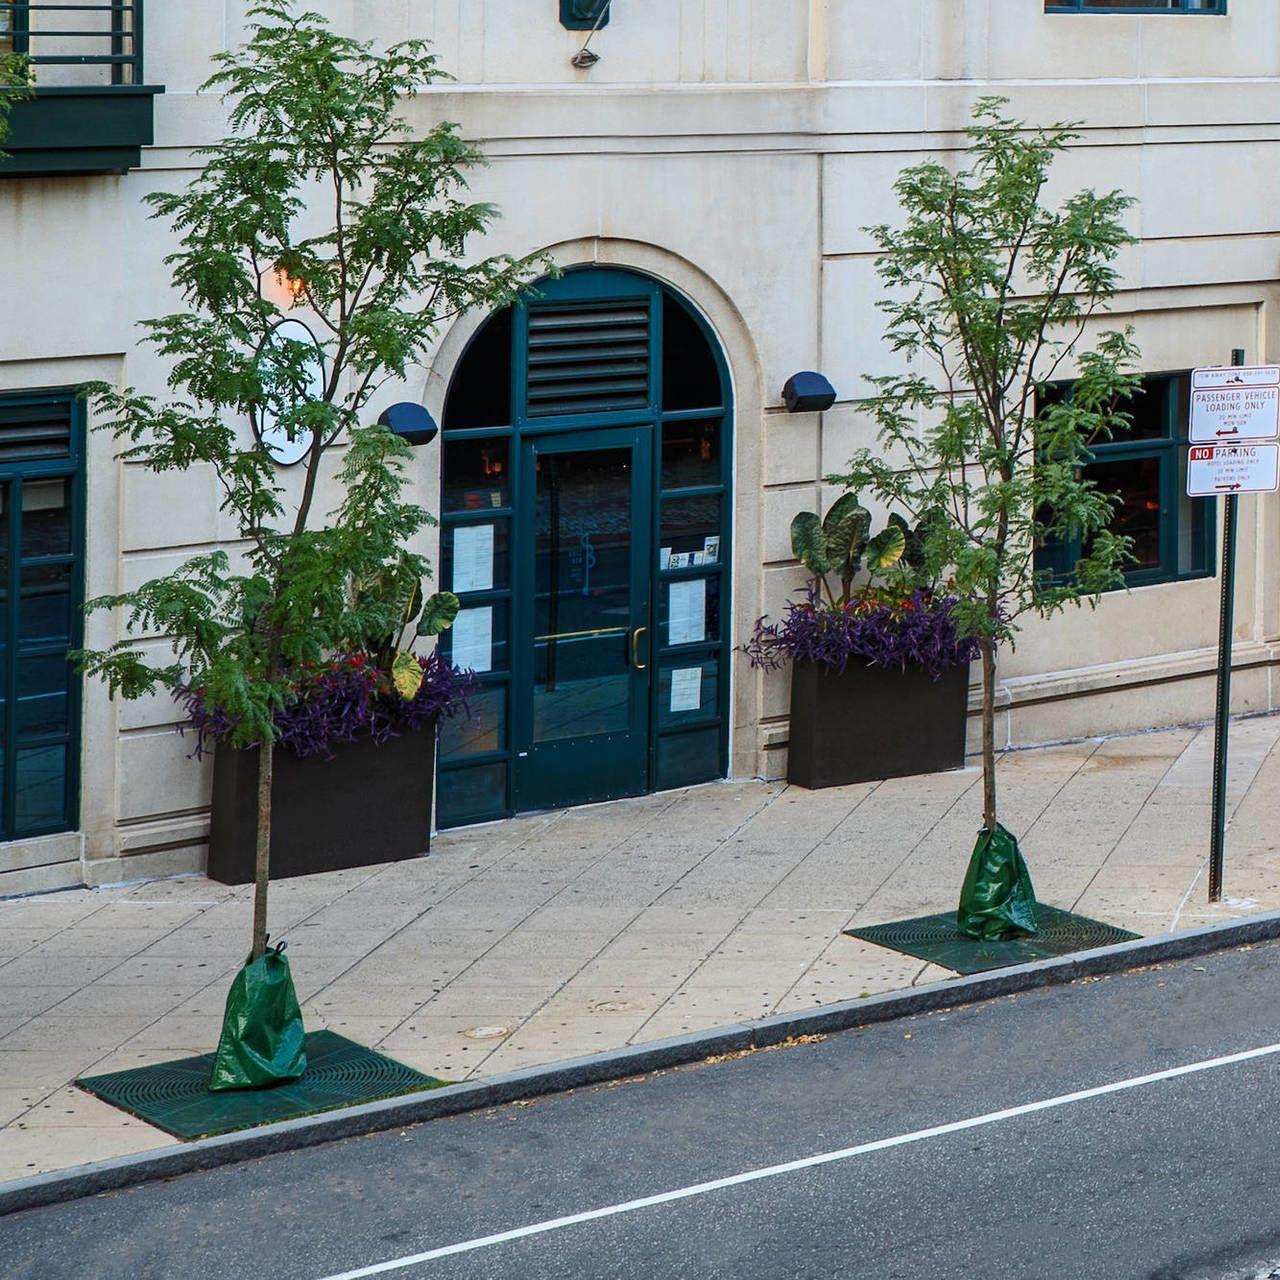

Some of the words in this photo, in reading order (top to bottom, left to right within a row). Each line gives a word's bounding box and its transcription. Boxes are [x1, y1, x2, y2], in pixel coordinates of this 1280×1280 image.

[1196, 392, 1241, 403] PASSENGER
[1244, 390, 1277, 401] VEHICLE
[1205, 402, 1241, 413] LOADING
[1244, 401, 1265, 410] ONLY
[1195, 448, 1209, 460] NO
[1215, 447, 1257, 459] PARKING
